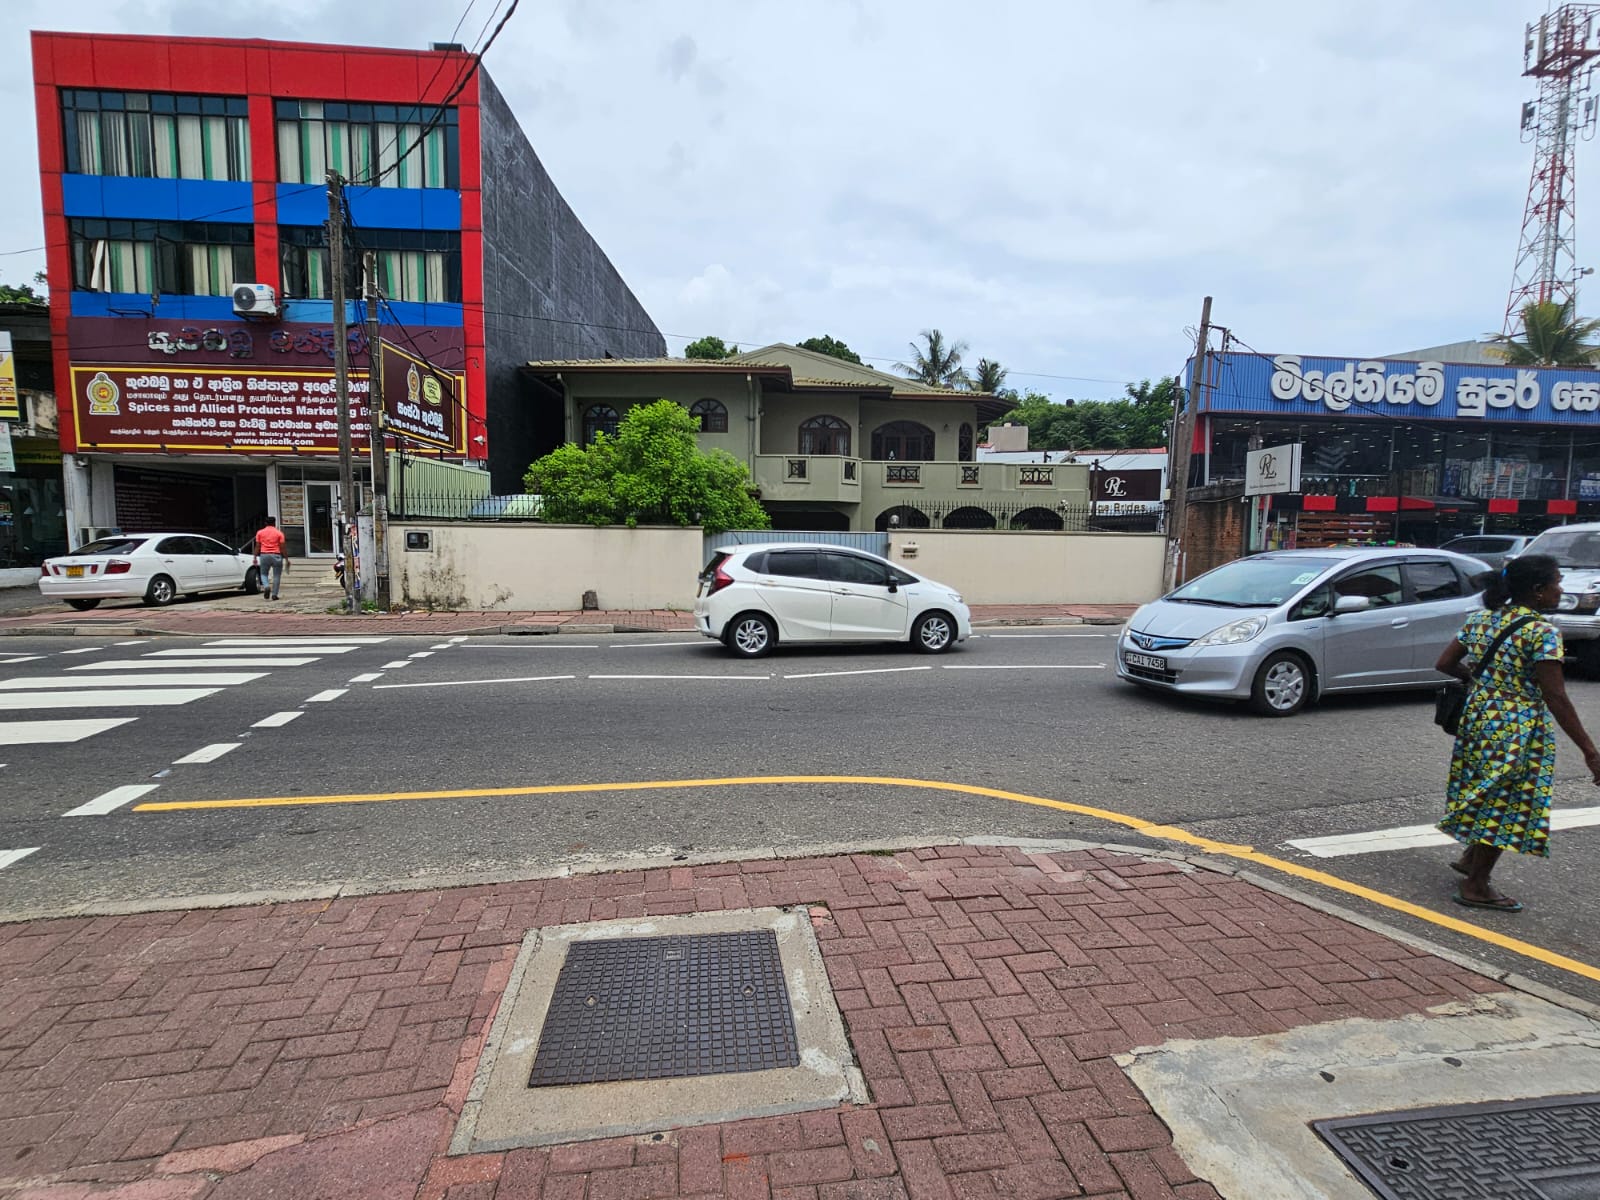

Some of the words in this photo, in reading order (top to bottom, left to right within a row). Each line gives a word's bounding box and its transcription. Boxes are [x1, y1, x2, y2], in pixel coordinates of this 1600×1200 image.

[173, 378, 188, 389] හා
[1271, 354, 1444, 411] මිලේනියම්
[1457, 369, 1540, 417] සුපර්
[128, 402, 170, 414] Spices
[173, 403, 197, 413] and
[200, 403, 235, 413] Allied
[238, 403, 292, 415] Products
[296, 405, 357, 418] Marketg
[234, 438, 314, 446] www.spicelk.com
[1113, 502, 1146, 512] Brides
[1132, 654, 1145, 666] CAI
[1147, 657, 1164, 669] 7458
